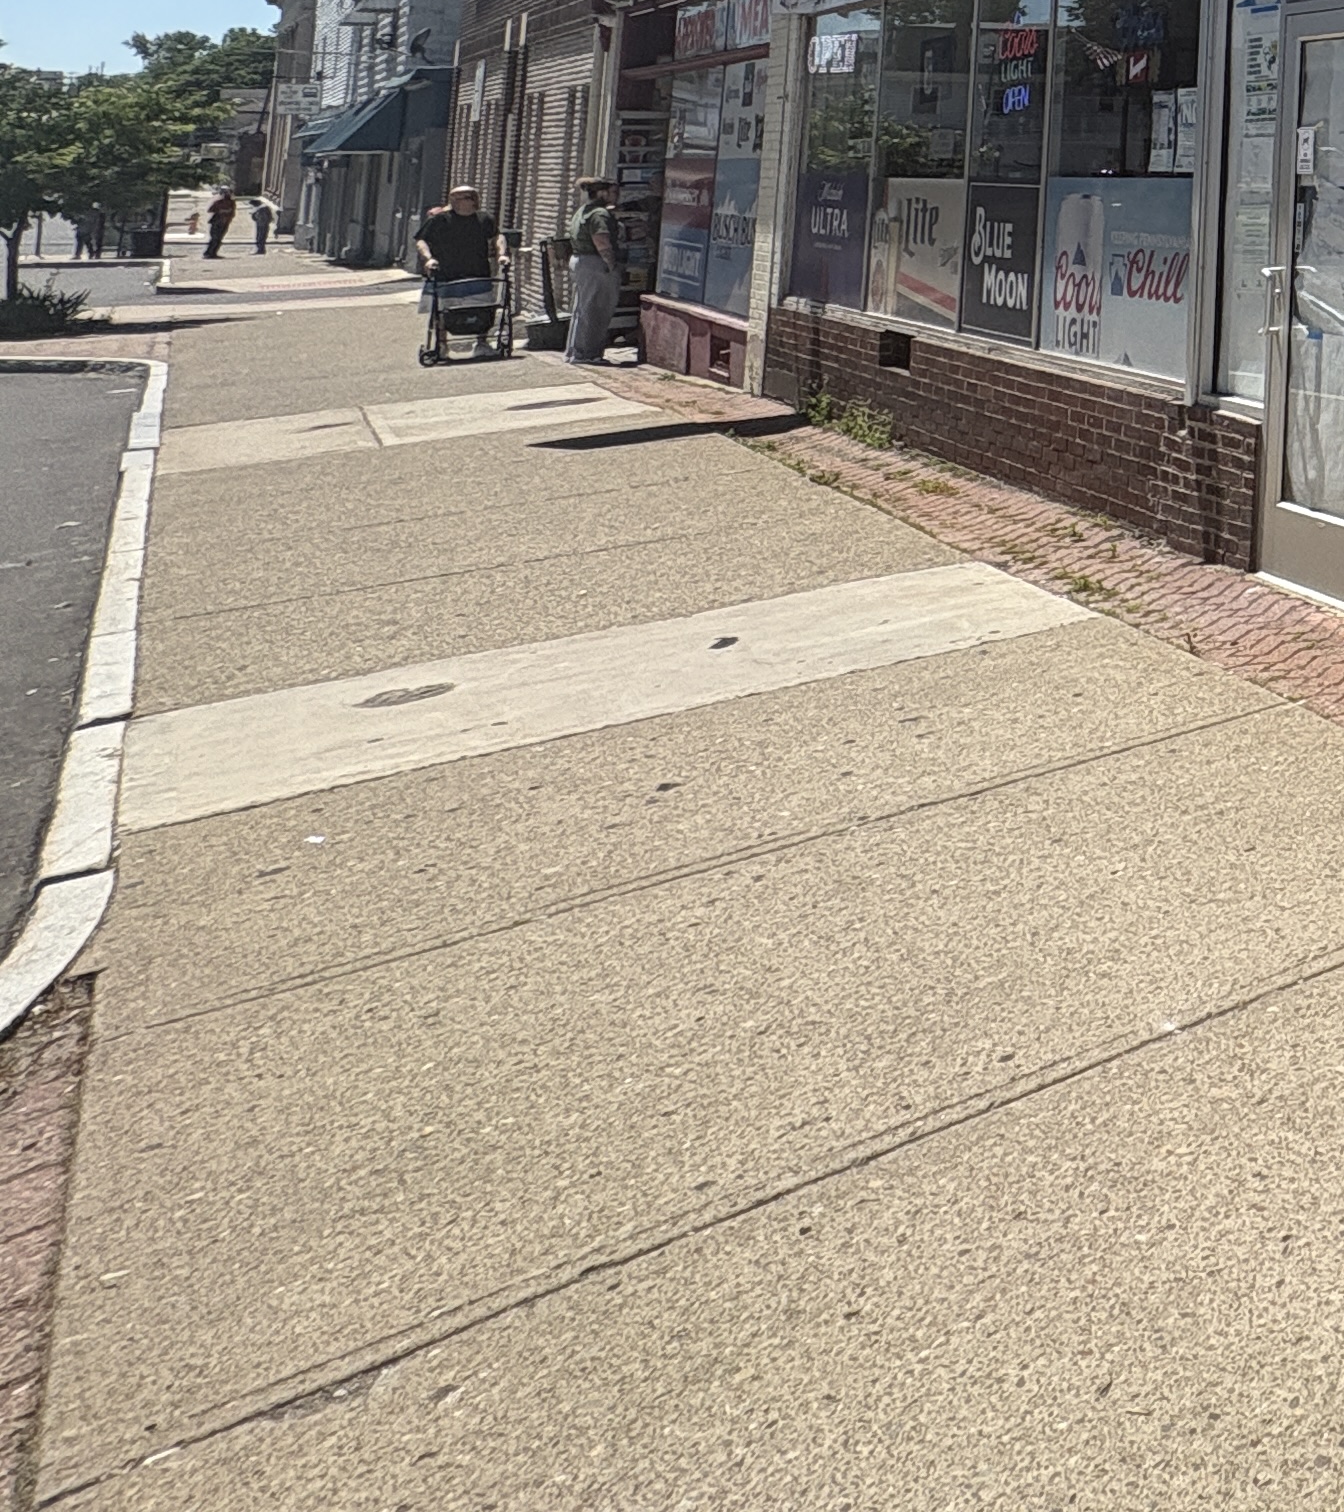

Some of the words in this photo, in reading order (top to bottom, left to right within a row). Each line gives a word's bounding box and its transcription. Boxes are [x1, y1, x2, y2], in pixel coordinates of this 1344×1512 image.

[808, 33, 859, 74] OPEN
[998, 22, 1039, 59] Coors
[1001, 58, 1033, 82] LIGHT
[1003, 84, 1030, 114] OPEN
[811, 206, 849, 238] ULTRA
[903, 196, 940, 259] Lite
[1053, 249, 1101, 317] Coors
[1126, 247, 1190, 305] Chill
[1055, 316, 1100, 356] LIGHT
